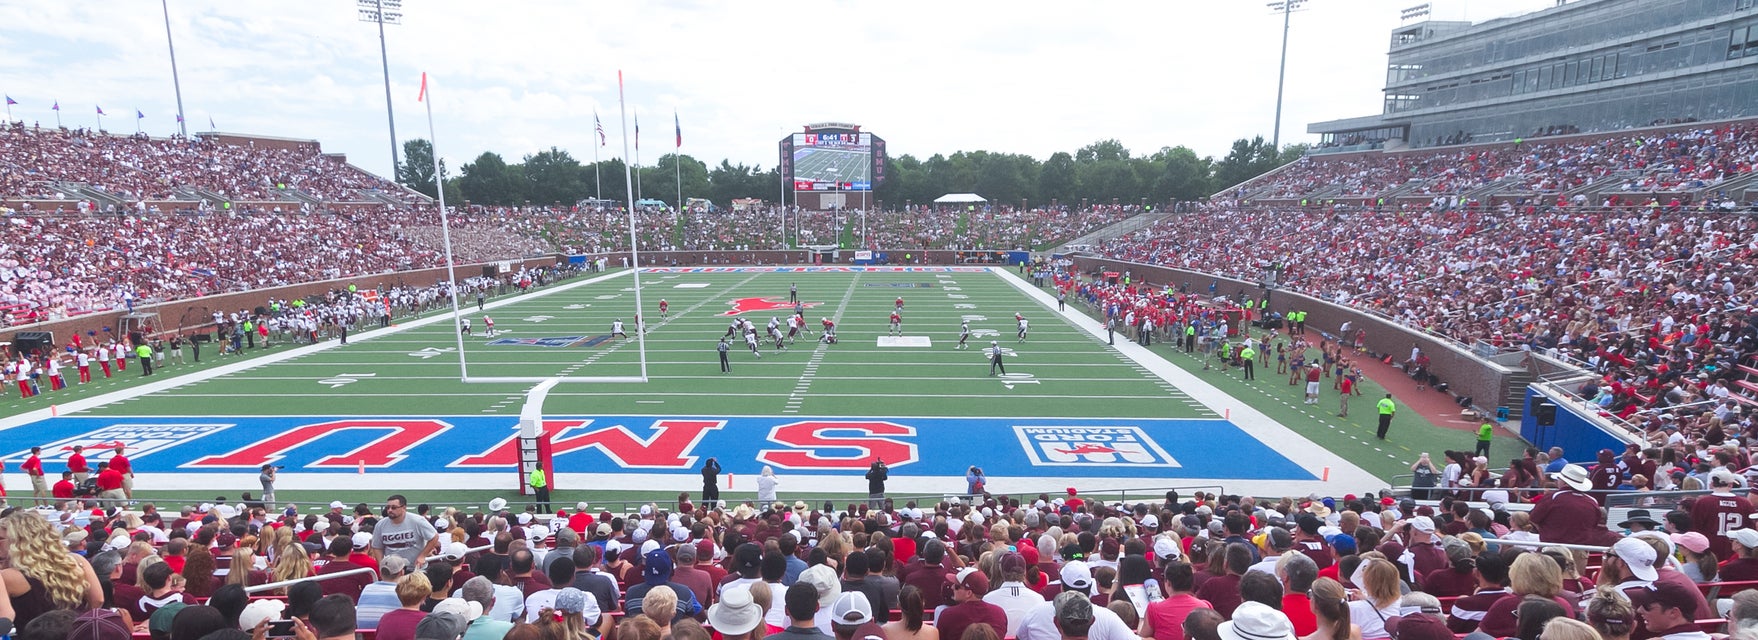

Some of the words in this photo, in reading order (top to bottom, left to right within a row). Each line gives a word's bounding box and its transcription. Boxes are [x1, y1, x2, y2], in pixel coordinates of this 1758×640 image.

[1034, 434, 1137, 442] FORD
[1607, 475, 1616, 487] 3
[1717, 512, 1742, 535] 12
[382, 531, 415, 542] AGGIES
